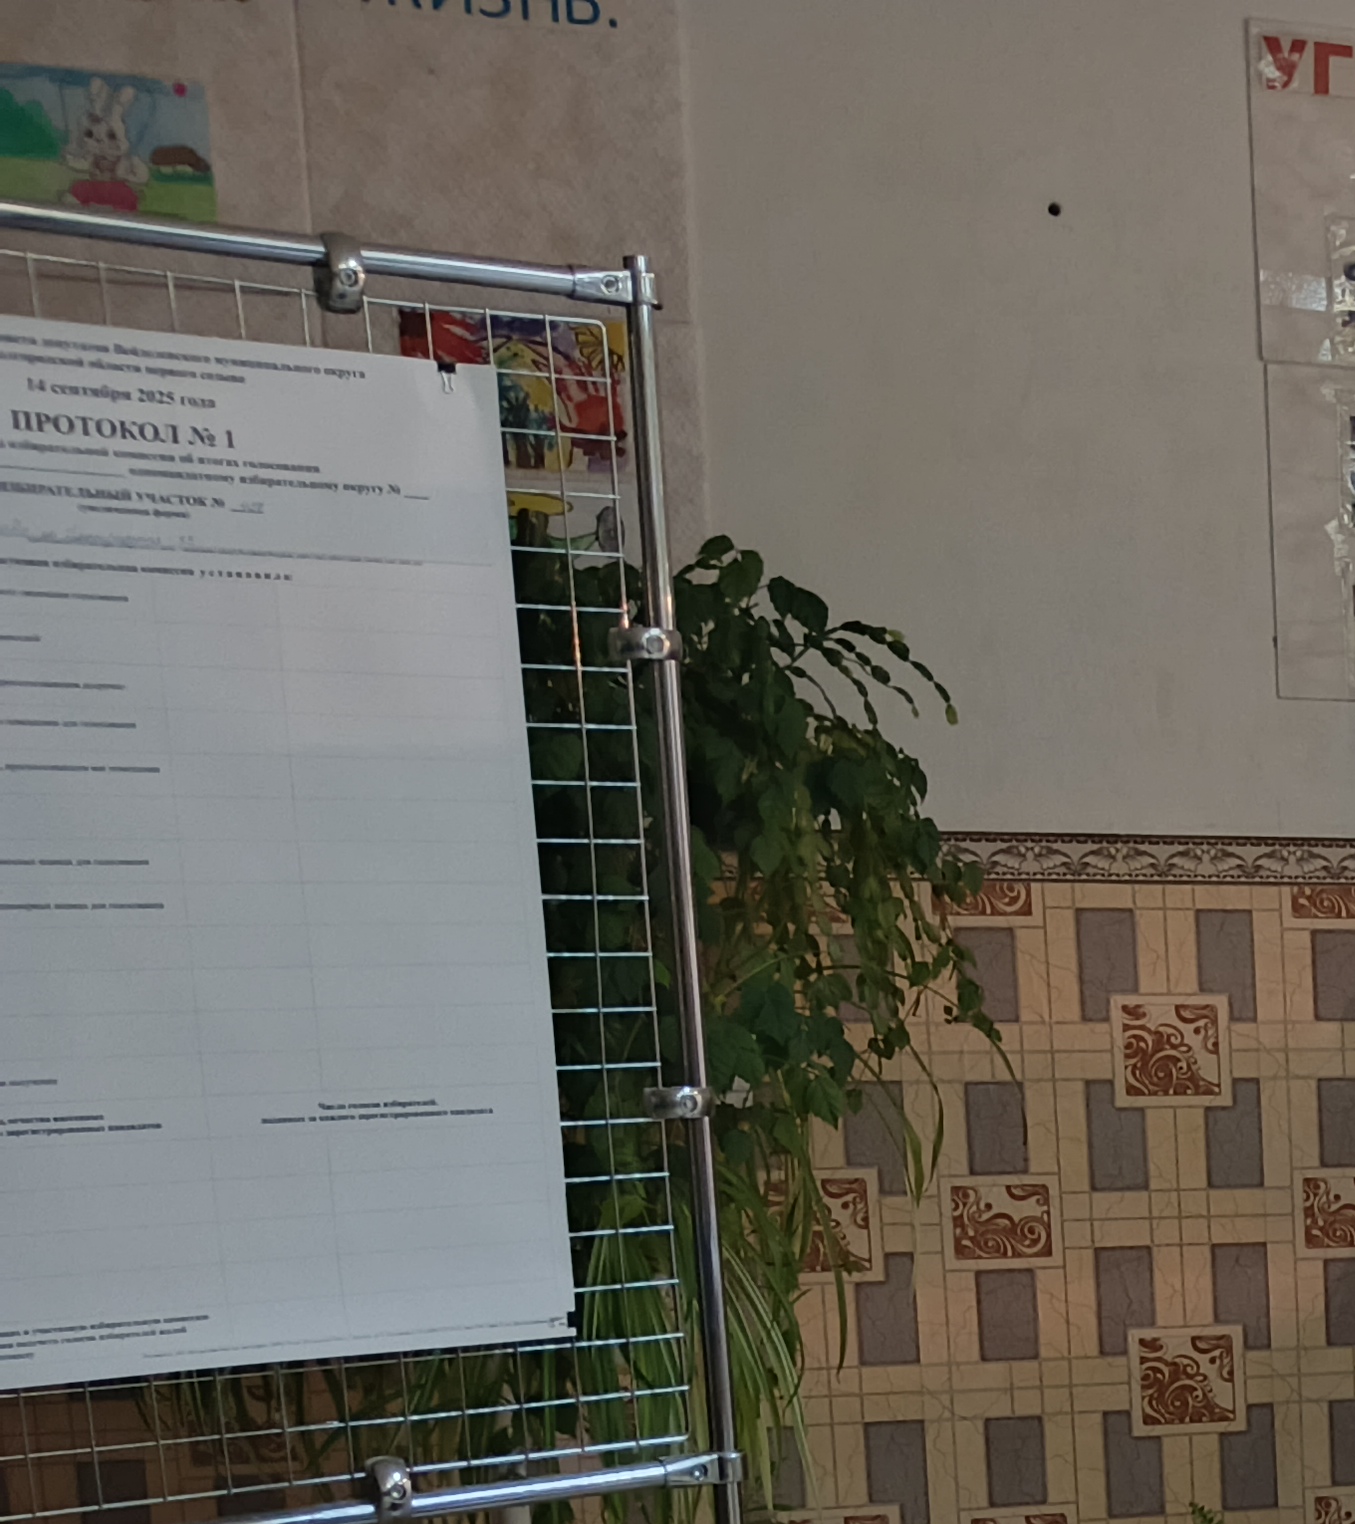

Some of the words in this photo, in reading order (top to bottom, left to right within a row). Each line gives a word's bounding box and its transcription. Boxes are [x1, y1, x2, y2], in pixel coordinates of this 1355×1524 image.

[26, 377, 46, 392] 14
[50, 384, 132, 403] сентября
[137, 388, 175, 405] 2025
[180, 395, 216, 408] года
[10, 409, 180, 445] ПРОТОКОЛ
[188, 425, 217, 447] №
[225, 430, 236, 449] 1
